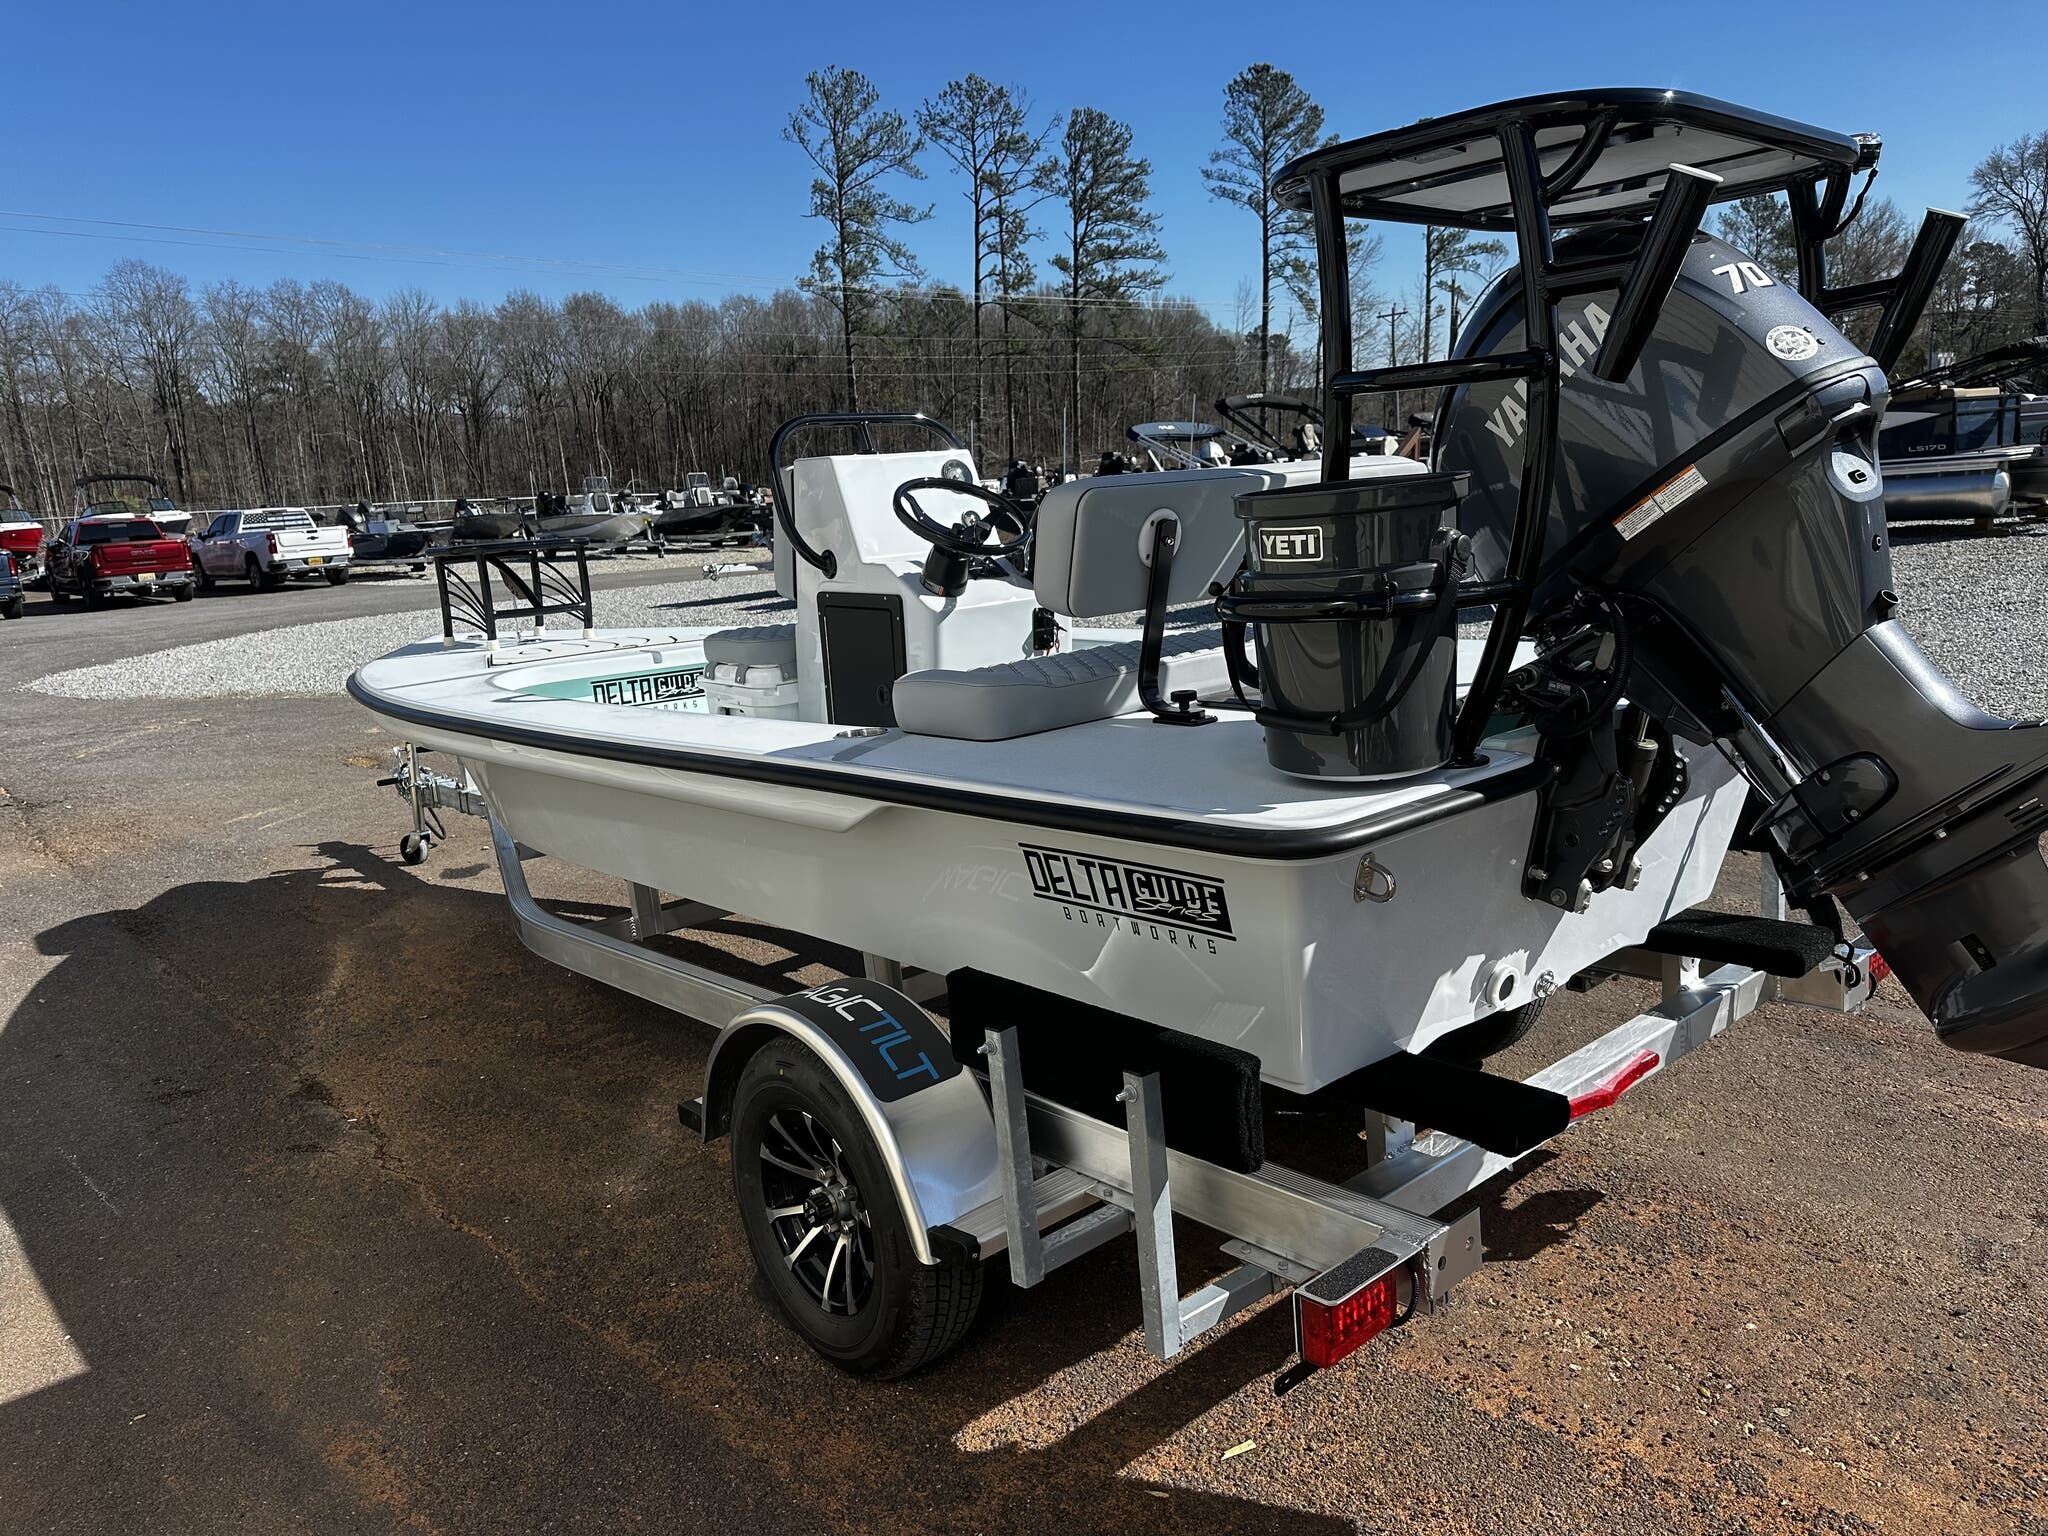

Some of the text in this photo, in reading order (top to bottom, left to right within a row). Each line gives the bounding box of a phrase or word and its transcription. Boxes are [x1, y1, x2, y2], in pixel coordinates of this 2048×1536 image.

[1711, 262, 1774, 294] 70
[1484, 302, 1611, 448] YAHA
[1908, 444, 1947, 453] LS170
[1261, 534, 1315, 556] YETI
[592, 678, 652, 706] DELTA
[1022, 849, 1222, 915] DELTA GUIDE
[1135, 896, 1218, 922] Series
[1062, 906, 1218, 955] BOATWORKS
[803, 985, 941, 1080] AGICTILT
